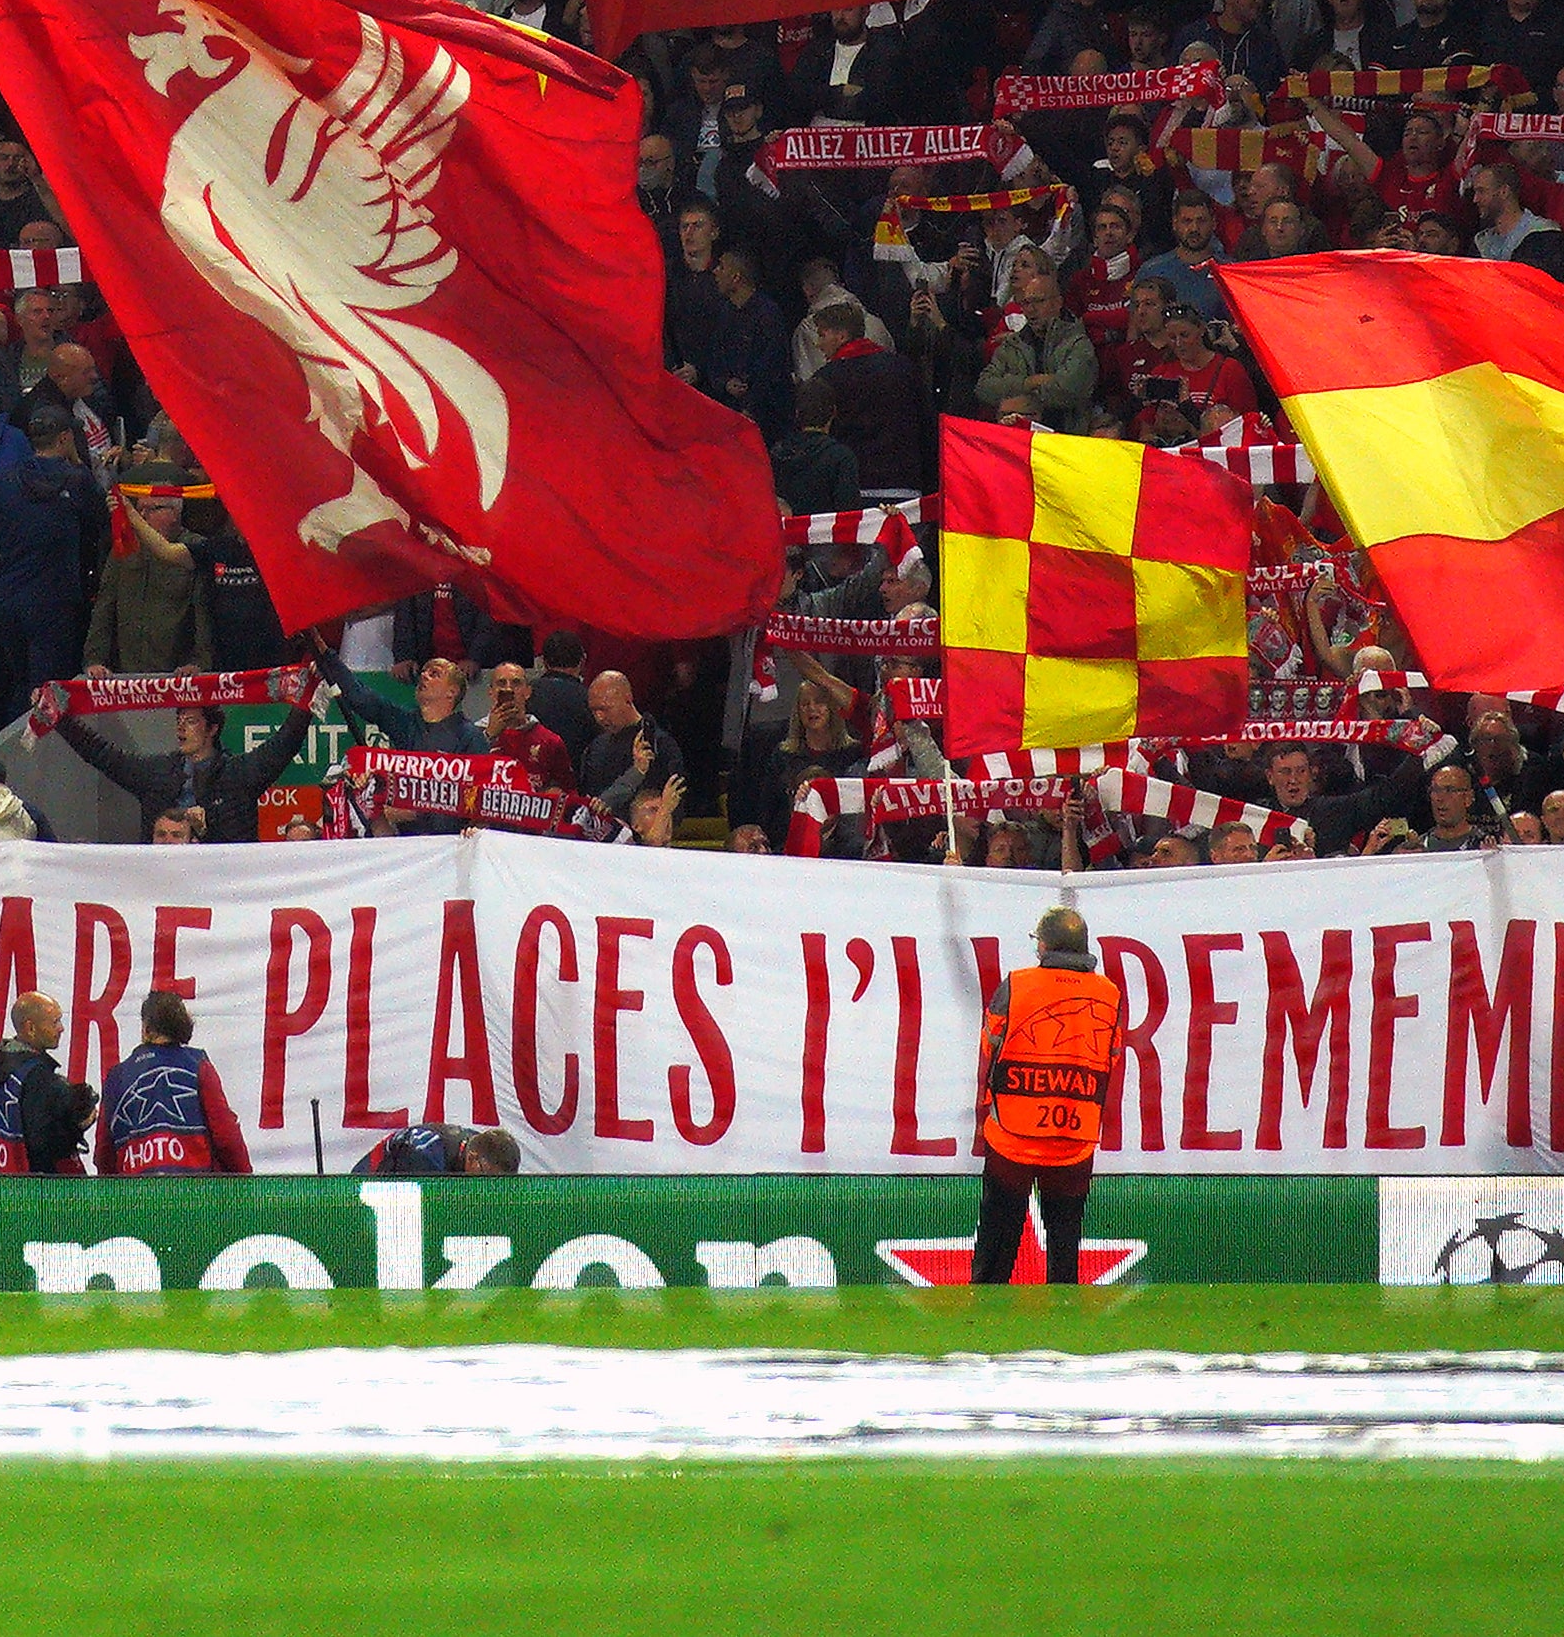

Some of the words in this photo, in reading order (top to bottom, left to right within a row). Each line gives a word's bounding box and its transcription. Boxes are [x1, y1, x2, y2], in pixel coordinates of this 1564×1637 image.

[1035, 71, 1138, 96] LIVERPOOL
[1144, 68, 1169, 87] FC
[785, 129, 845, 161] ALLEZ
[855, 128, 916, 158] ALLEZ
[923, 125, 983, 155] ALLEZ
[767, 628, 809, 643] YOU'LL
[813, 632, 854, 645] NEVER
[856, 634, 891, 647] WALK
[895, 636, 935, 648] ALONE
[88, 672, 199, 697] LIVERPOOL
[218, 671, 244, 690] FC
[92, 691, 126, 706] YOU'LL
[131, 690, 165, 705] NEVER
[173, 689, 202, 703] WALK
[211, 687, 246, 701] ALONE
[243, 724, 350, 765] EIT
[364, 751, 474, 781] LIVERPOOL
[491, 758, 517, 783] FC
[398, 776, 460, 807] STEVEN
[482, 789, 553, 821] GERRARD
[1004, 796, 1044, 809] CLUB
[258, 898, 736, 1146] PLACES
[1036, 1104, 1082, 1131] 206
